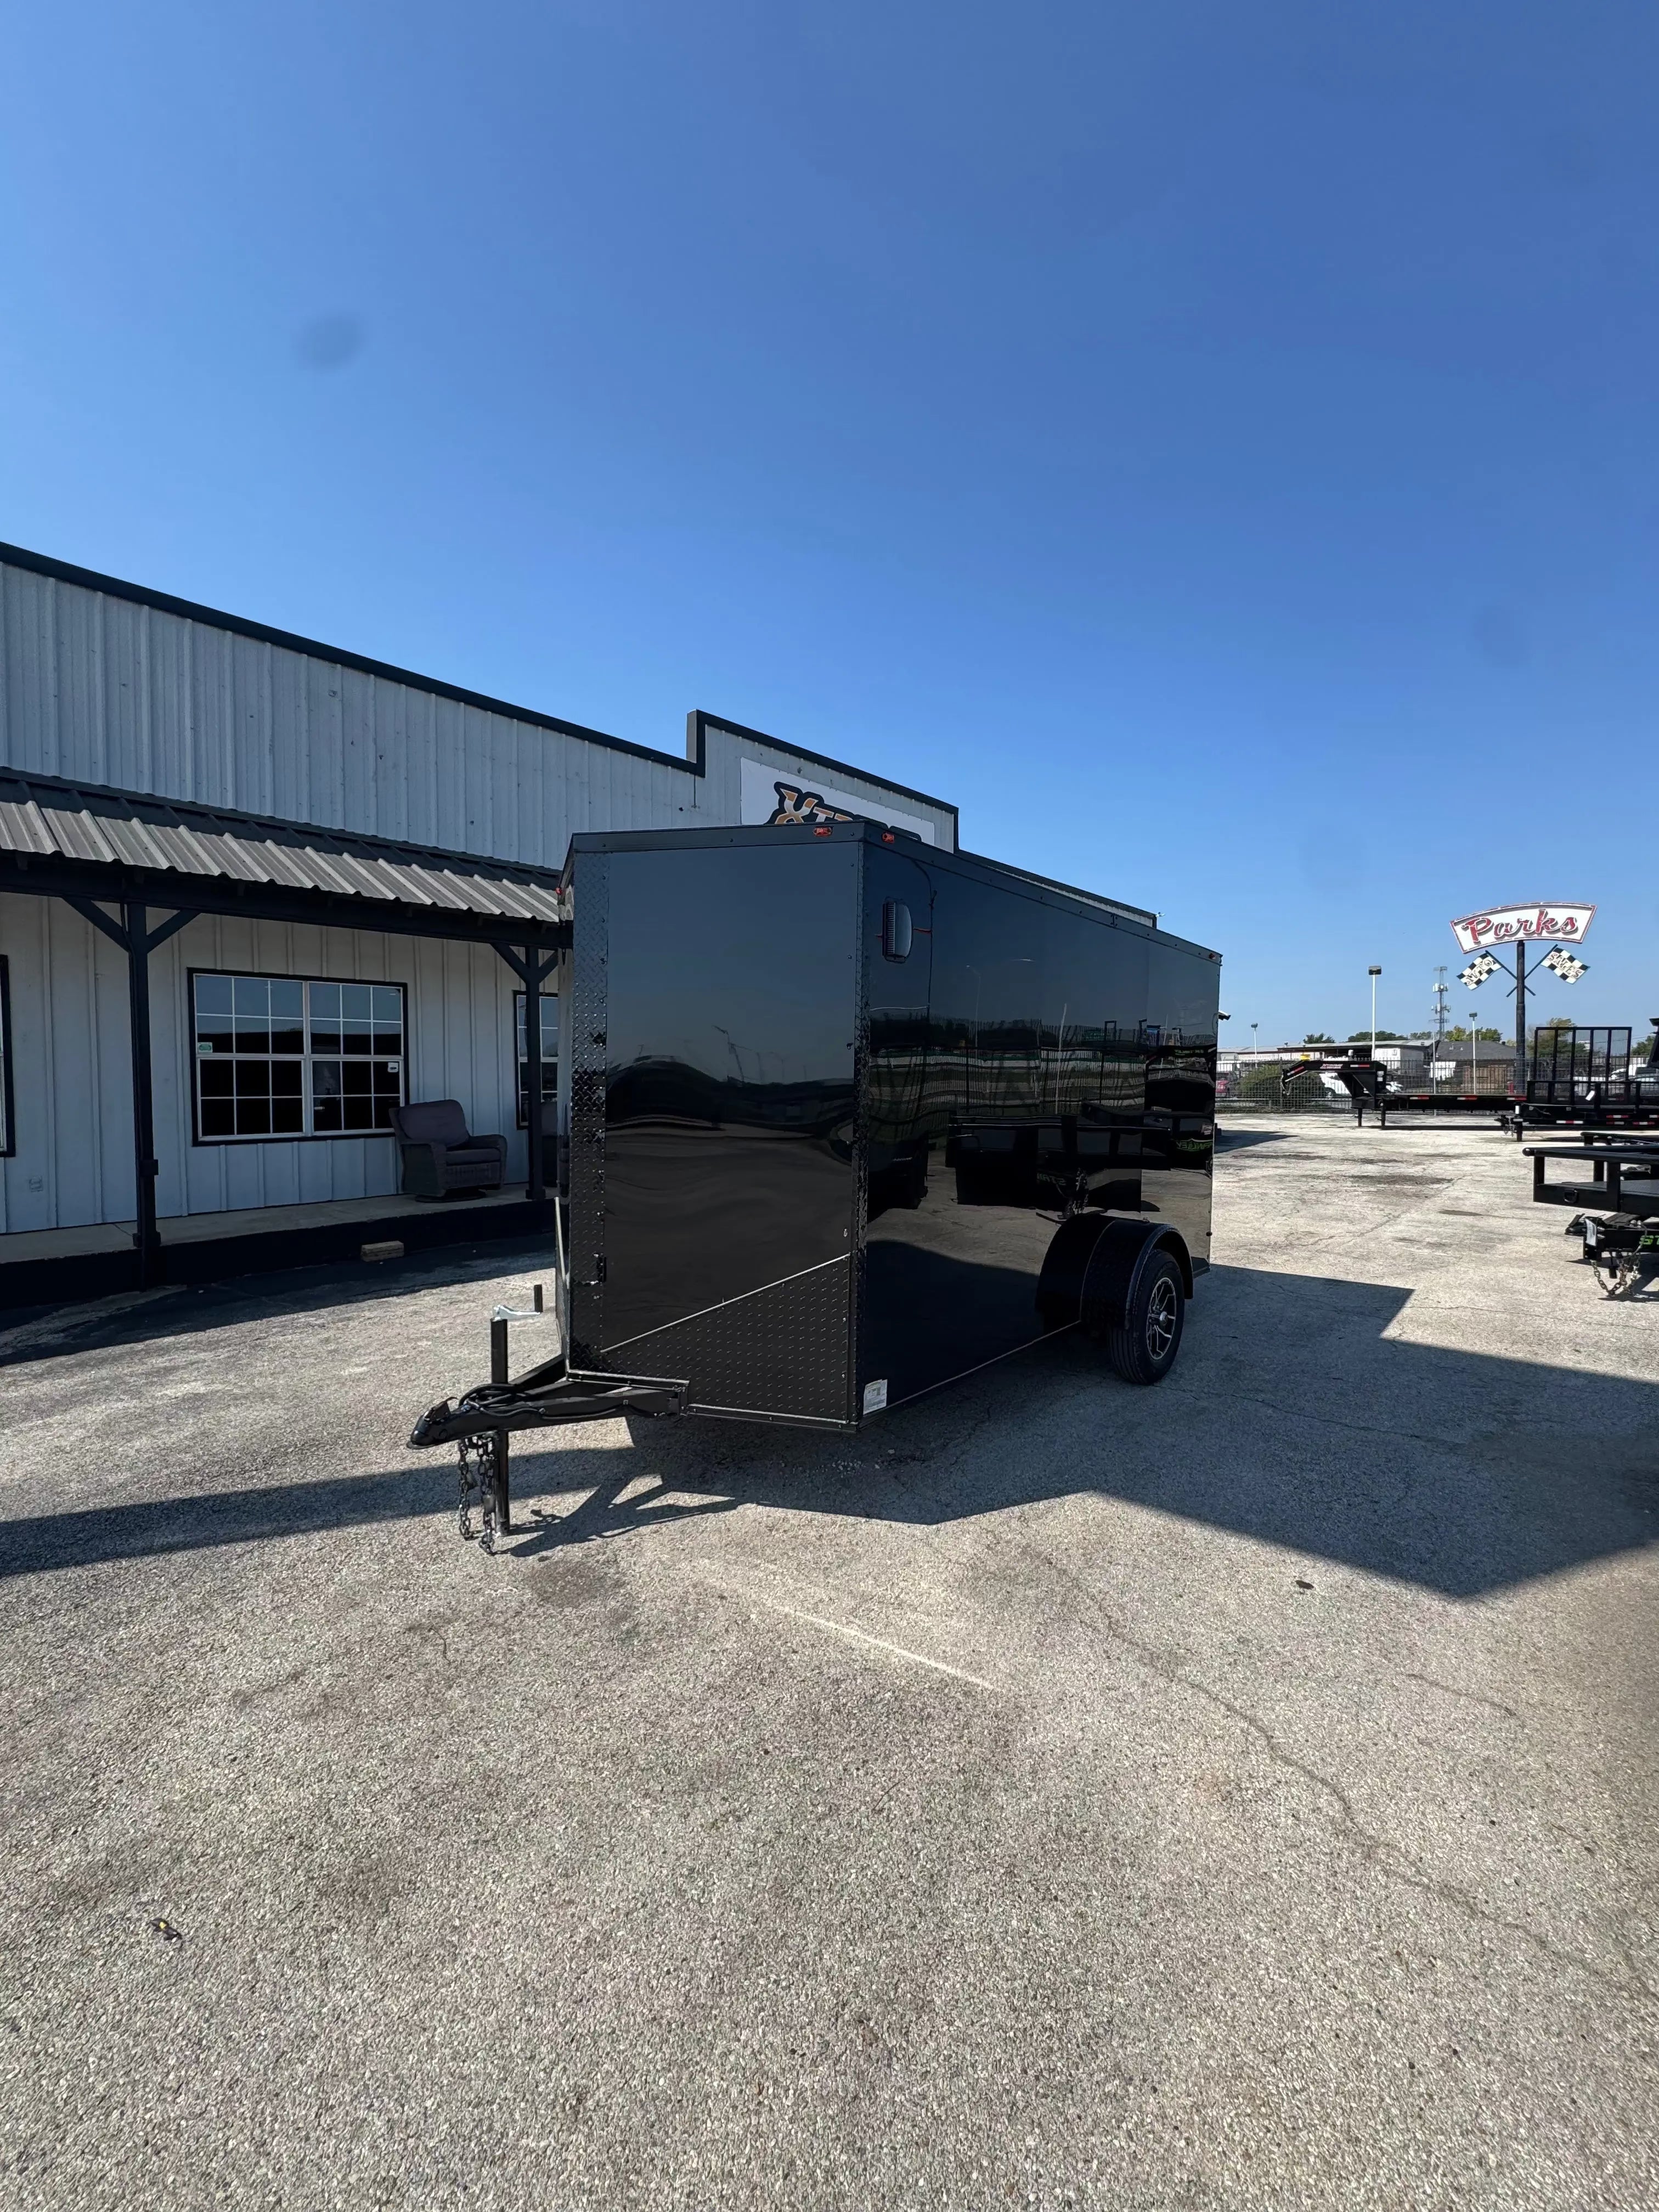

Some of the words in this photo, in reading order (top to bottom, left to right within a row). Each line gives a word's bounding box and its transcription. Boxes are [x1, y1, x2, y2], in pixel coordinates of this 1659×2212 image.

[774, 788, 854, 824] XT
[1462, 909, 1578, 944] Parks
[1465, 958, 1495, 986] AUTO
[1547, 952, 1583, 978] SALES
